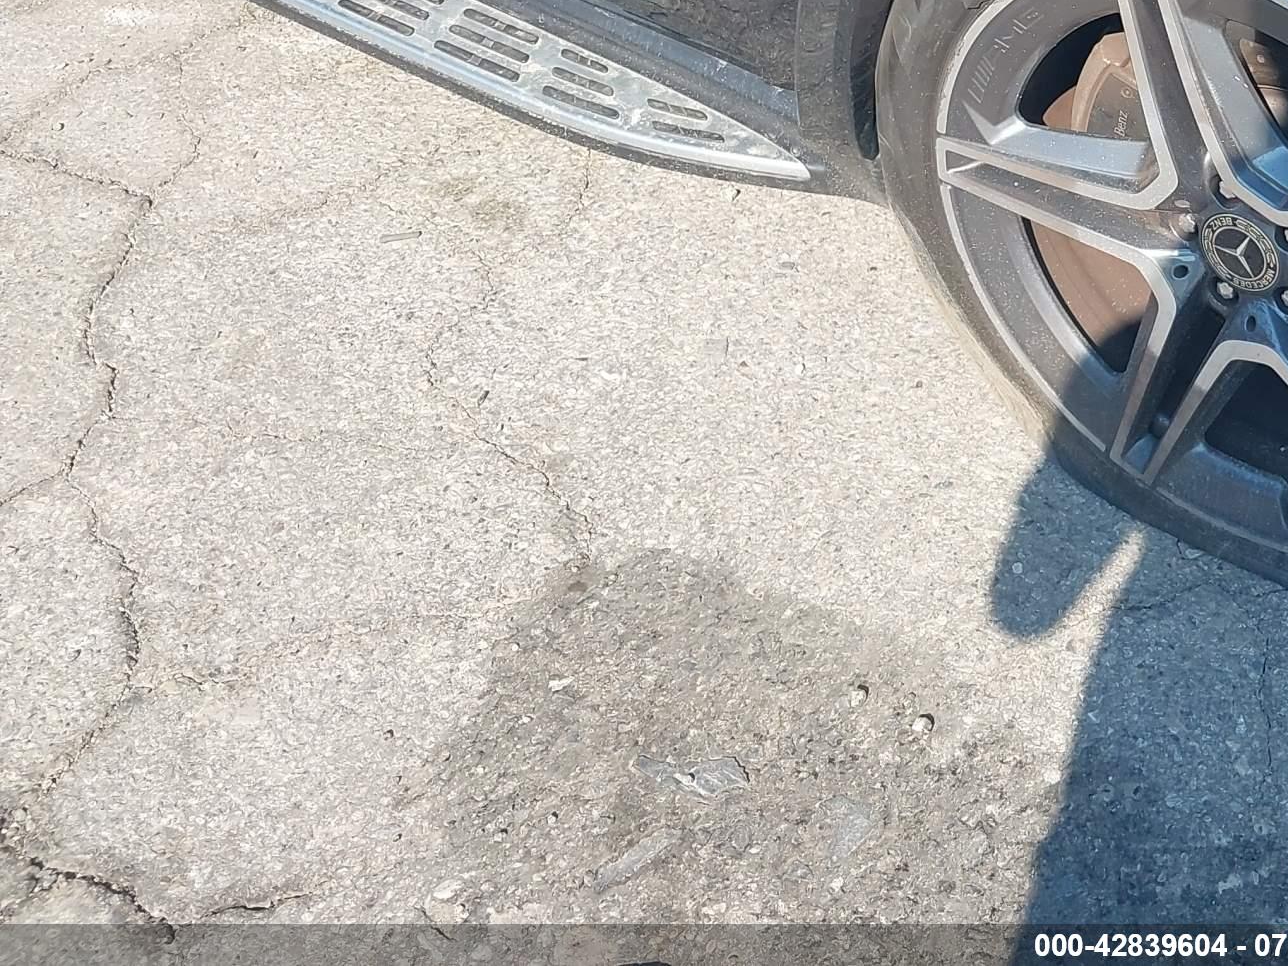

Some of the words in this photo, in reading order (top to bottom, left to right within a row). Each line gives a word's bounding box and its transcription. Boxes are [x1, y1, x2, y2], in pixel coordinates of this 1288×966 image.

[1113, 109, 1129, 138] Benz
[1209, 216, 1234, 230] BENZ
[1232, 268, 1277, 290] MERCEDES
